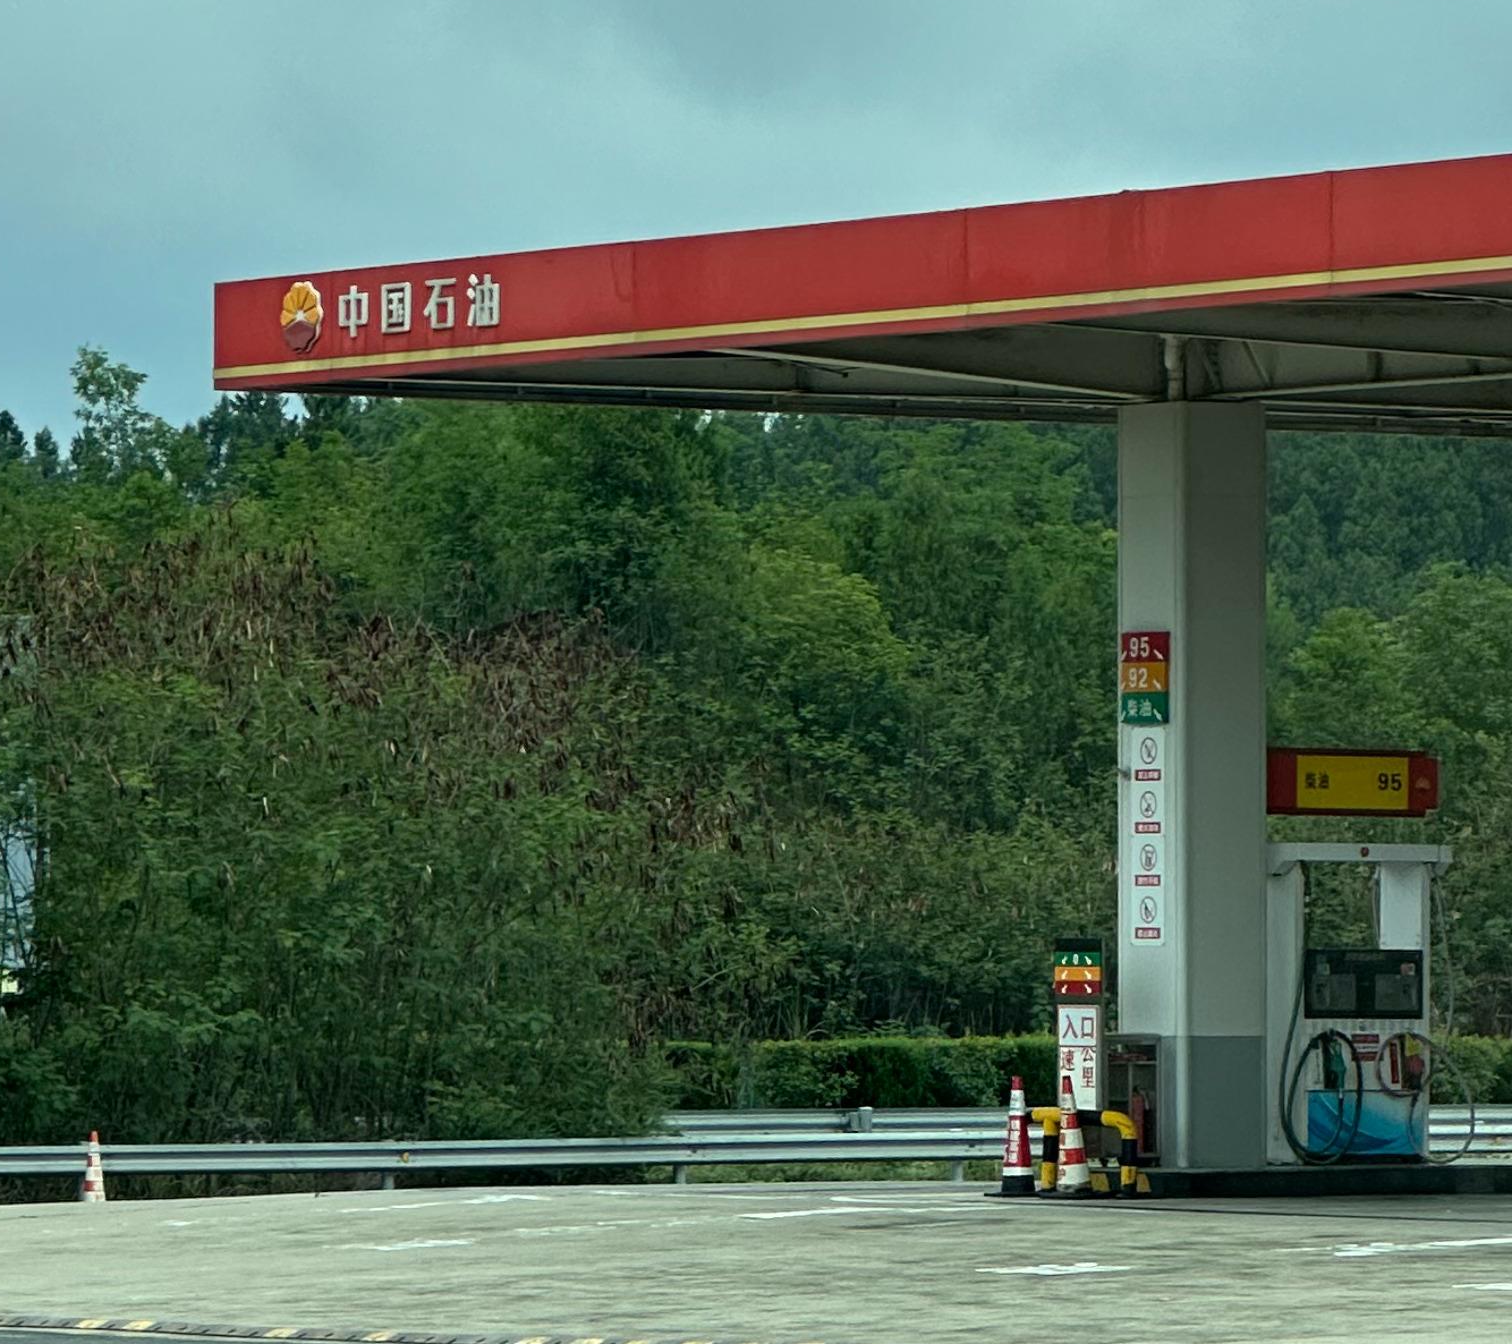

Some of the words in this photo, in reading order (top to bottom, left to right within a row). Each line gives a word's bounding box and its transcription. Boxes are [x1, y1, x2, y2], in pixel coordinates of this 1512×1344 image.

[338, 273, 501, 338] 中国石油
[1129, 636, 1150, 658] 95
[1129, 667, 1148, 689] 92
[1377, 773, 1403, 791] 95
[1062, 1013, 1096, 1040] 入口
